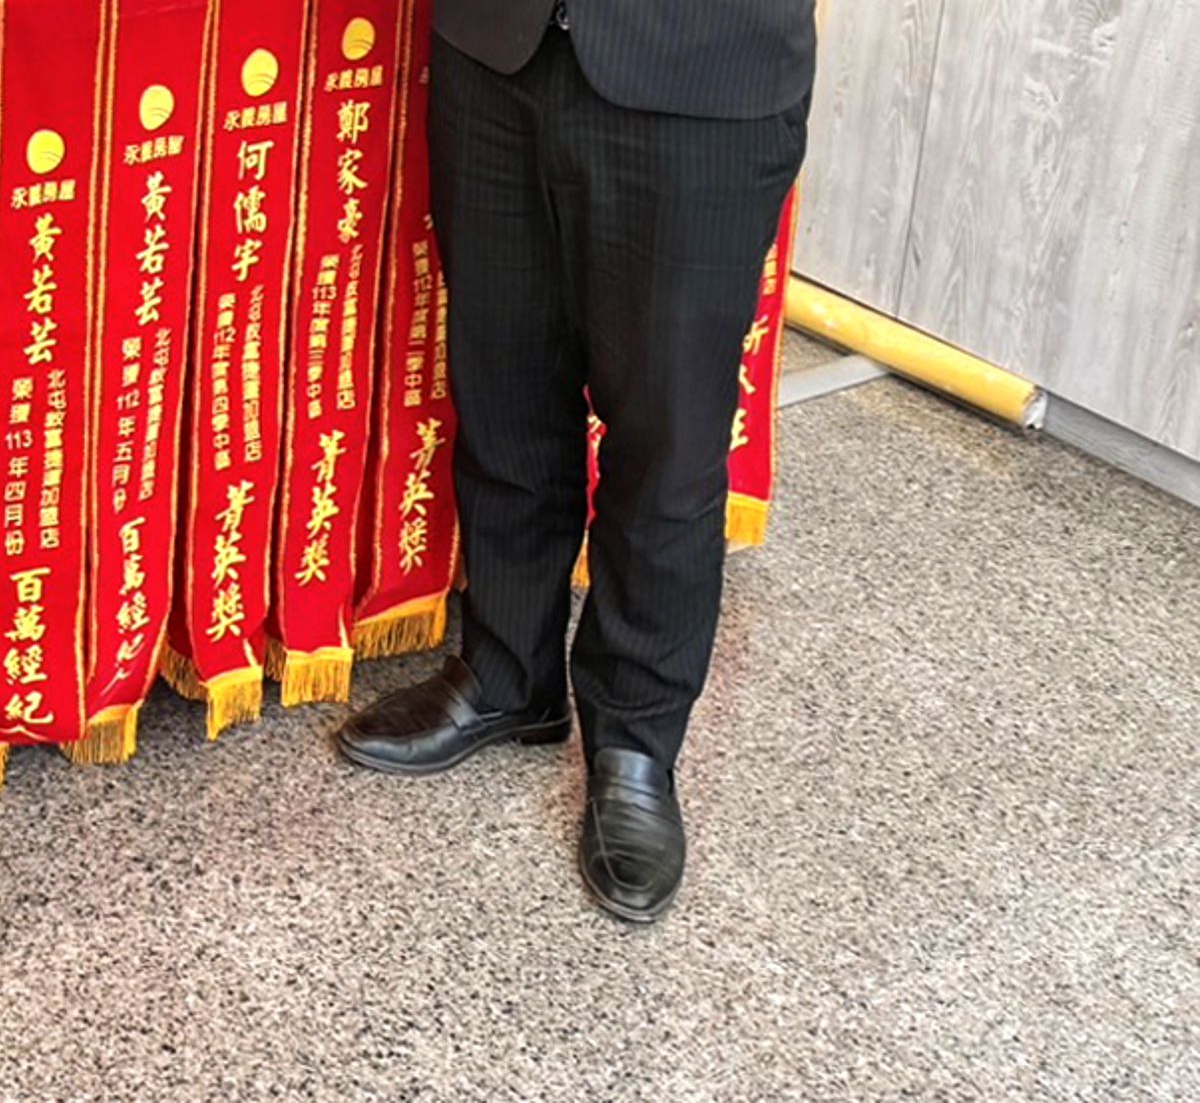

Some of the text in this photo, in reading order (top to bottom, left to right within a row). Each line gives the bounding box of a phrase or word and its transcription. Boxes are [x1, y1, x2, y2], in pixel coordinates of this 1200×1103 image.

[11, 179, 76, 210] 永義房屋
[134, 170, 172, 326] 黃若芸
[231, 140, 275, 282] 何儒宇
[23, 212, 62, 365] 黃若芸
[205, 479, 255, 642] 菁英獎
[294, 429, 346, 586] 菁英獎
[398, 417, 446, 575] 菁英獎
